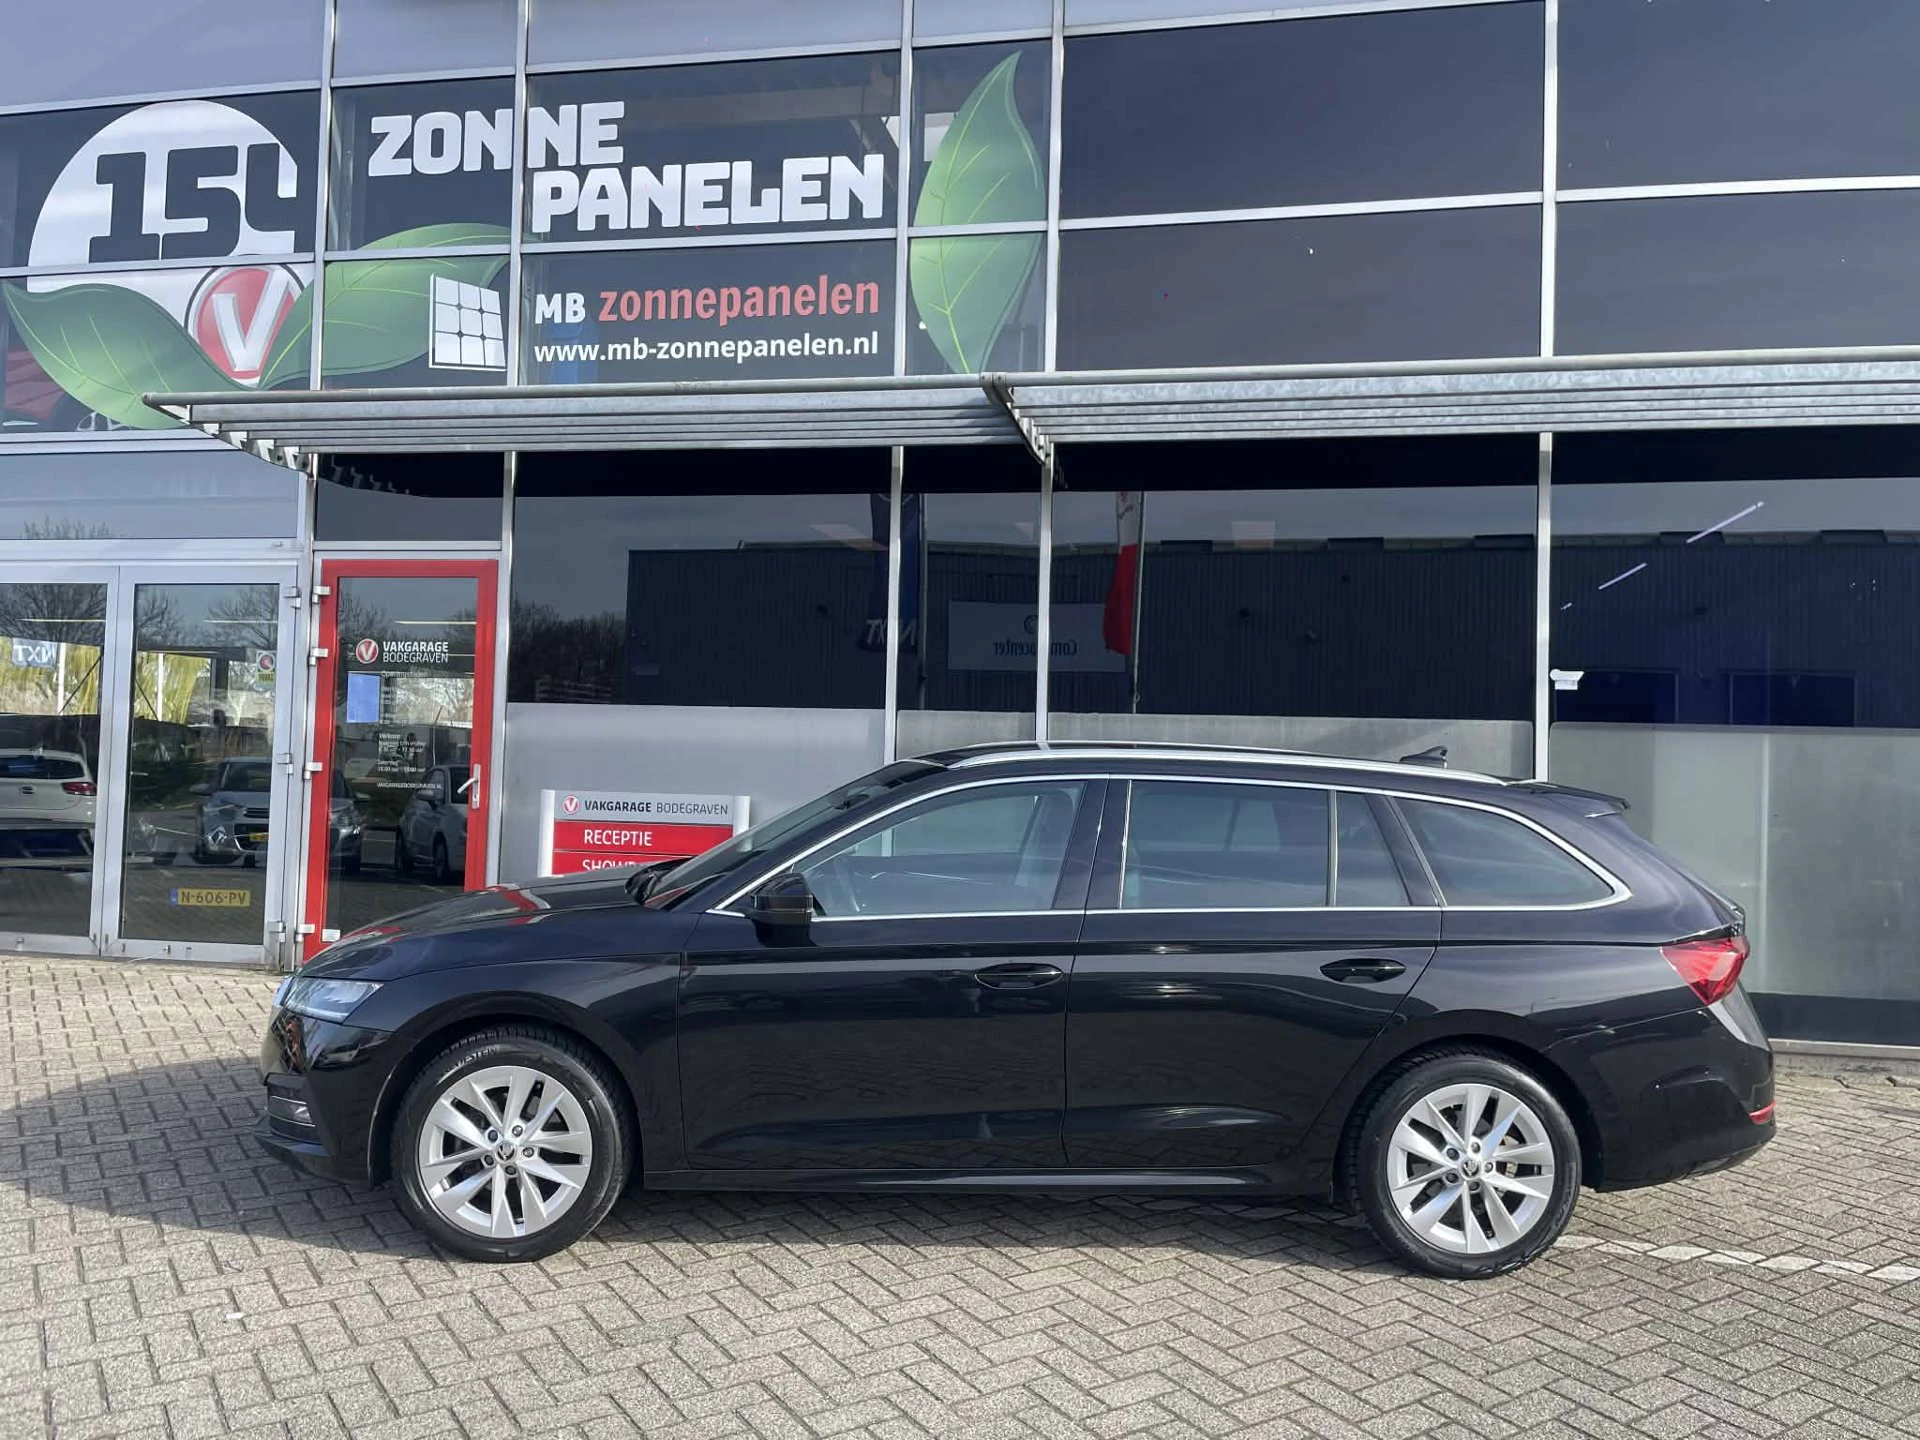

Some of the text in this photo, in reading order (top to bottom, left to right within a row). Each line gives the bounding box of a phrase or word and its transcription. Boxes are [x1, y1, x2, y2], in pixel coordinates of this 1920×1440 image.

[368, 101, 625, 177] ZONNE
[89, 141, 301, 263] 154
[532, 154, 885, 233] PANELEN
[535, 274, 880, 327] MB zonnepanelen
[534, 331, 879, 364] www.mb-zonnepanelen.nl
[383, 641, 449, 652] VAKGARAGE
[383, 652, 449, 663] BODEGRAVEN
[584, 800, 652, 813] VAKGARAGE
[656, 802, 728, 815] BODEGRAVEN
[584, 829, 653, 847] RECEPTIE
[181, 891, 246, 904] N-606-PV
